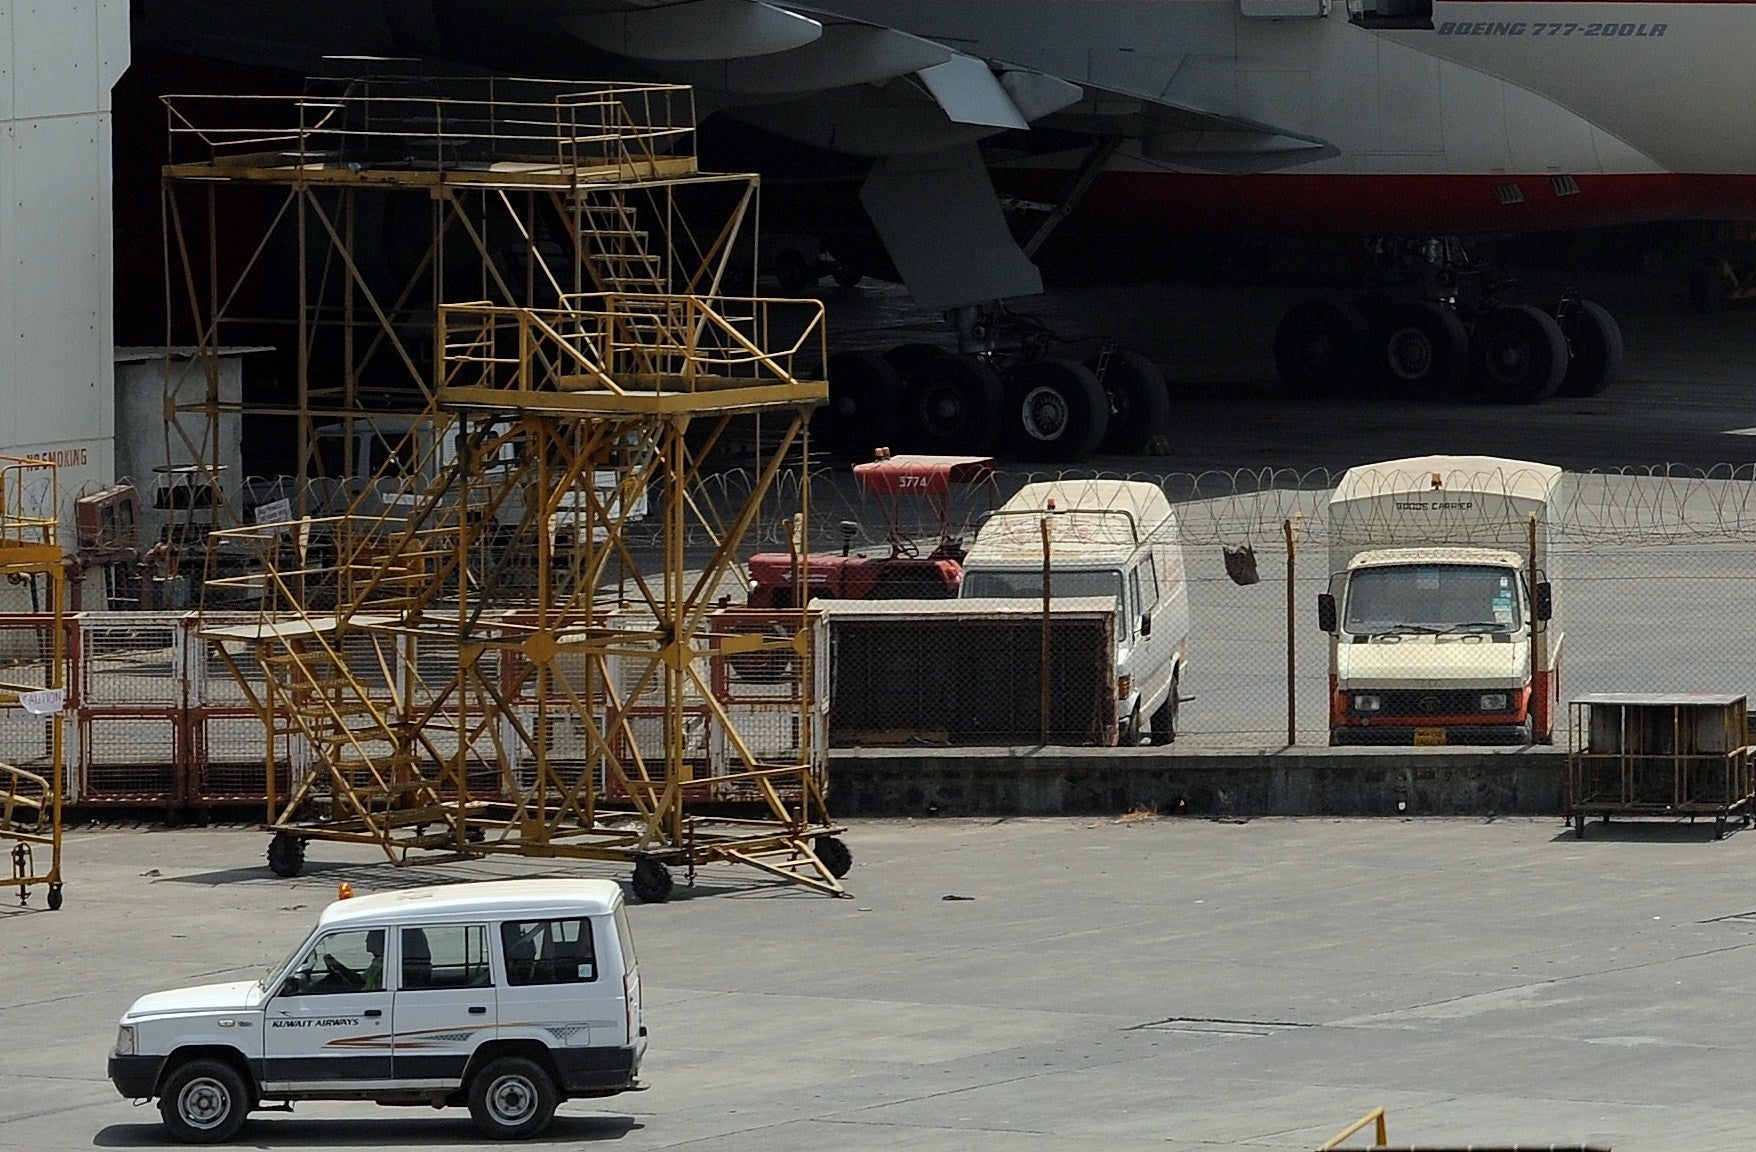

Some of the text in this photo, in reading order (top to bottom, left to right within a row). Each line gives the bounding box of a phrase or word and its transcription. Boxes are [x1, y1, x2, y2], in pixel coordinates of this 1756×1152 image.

[1439, 22, 1668, 37] BOEING 777-200LR
[42, 448, 87, 469] SMOKING
[272, 1018, 359, 1028] KUWAIT AIRWAYS
